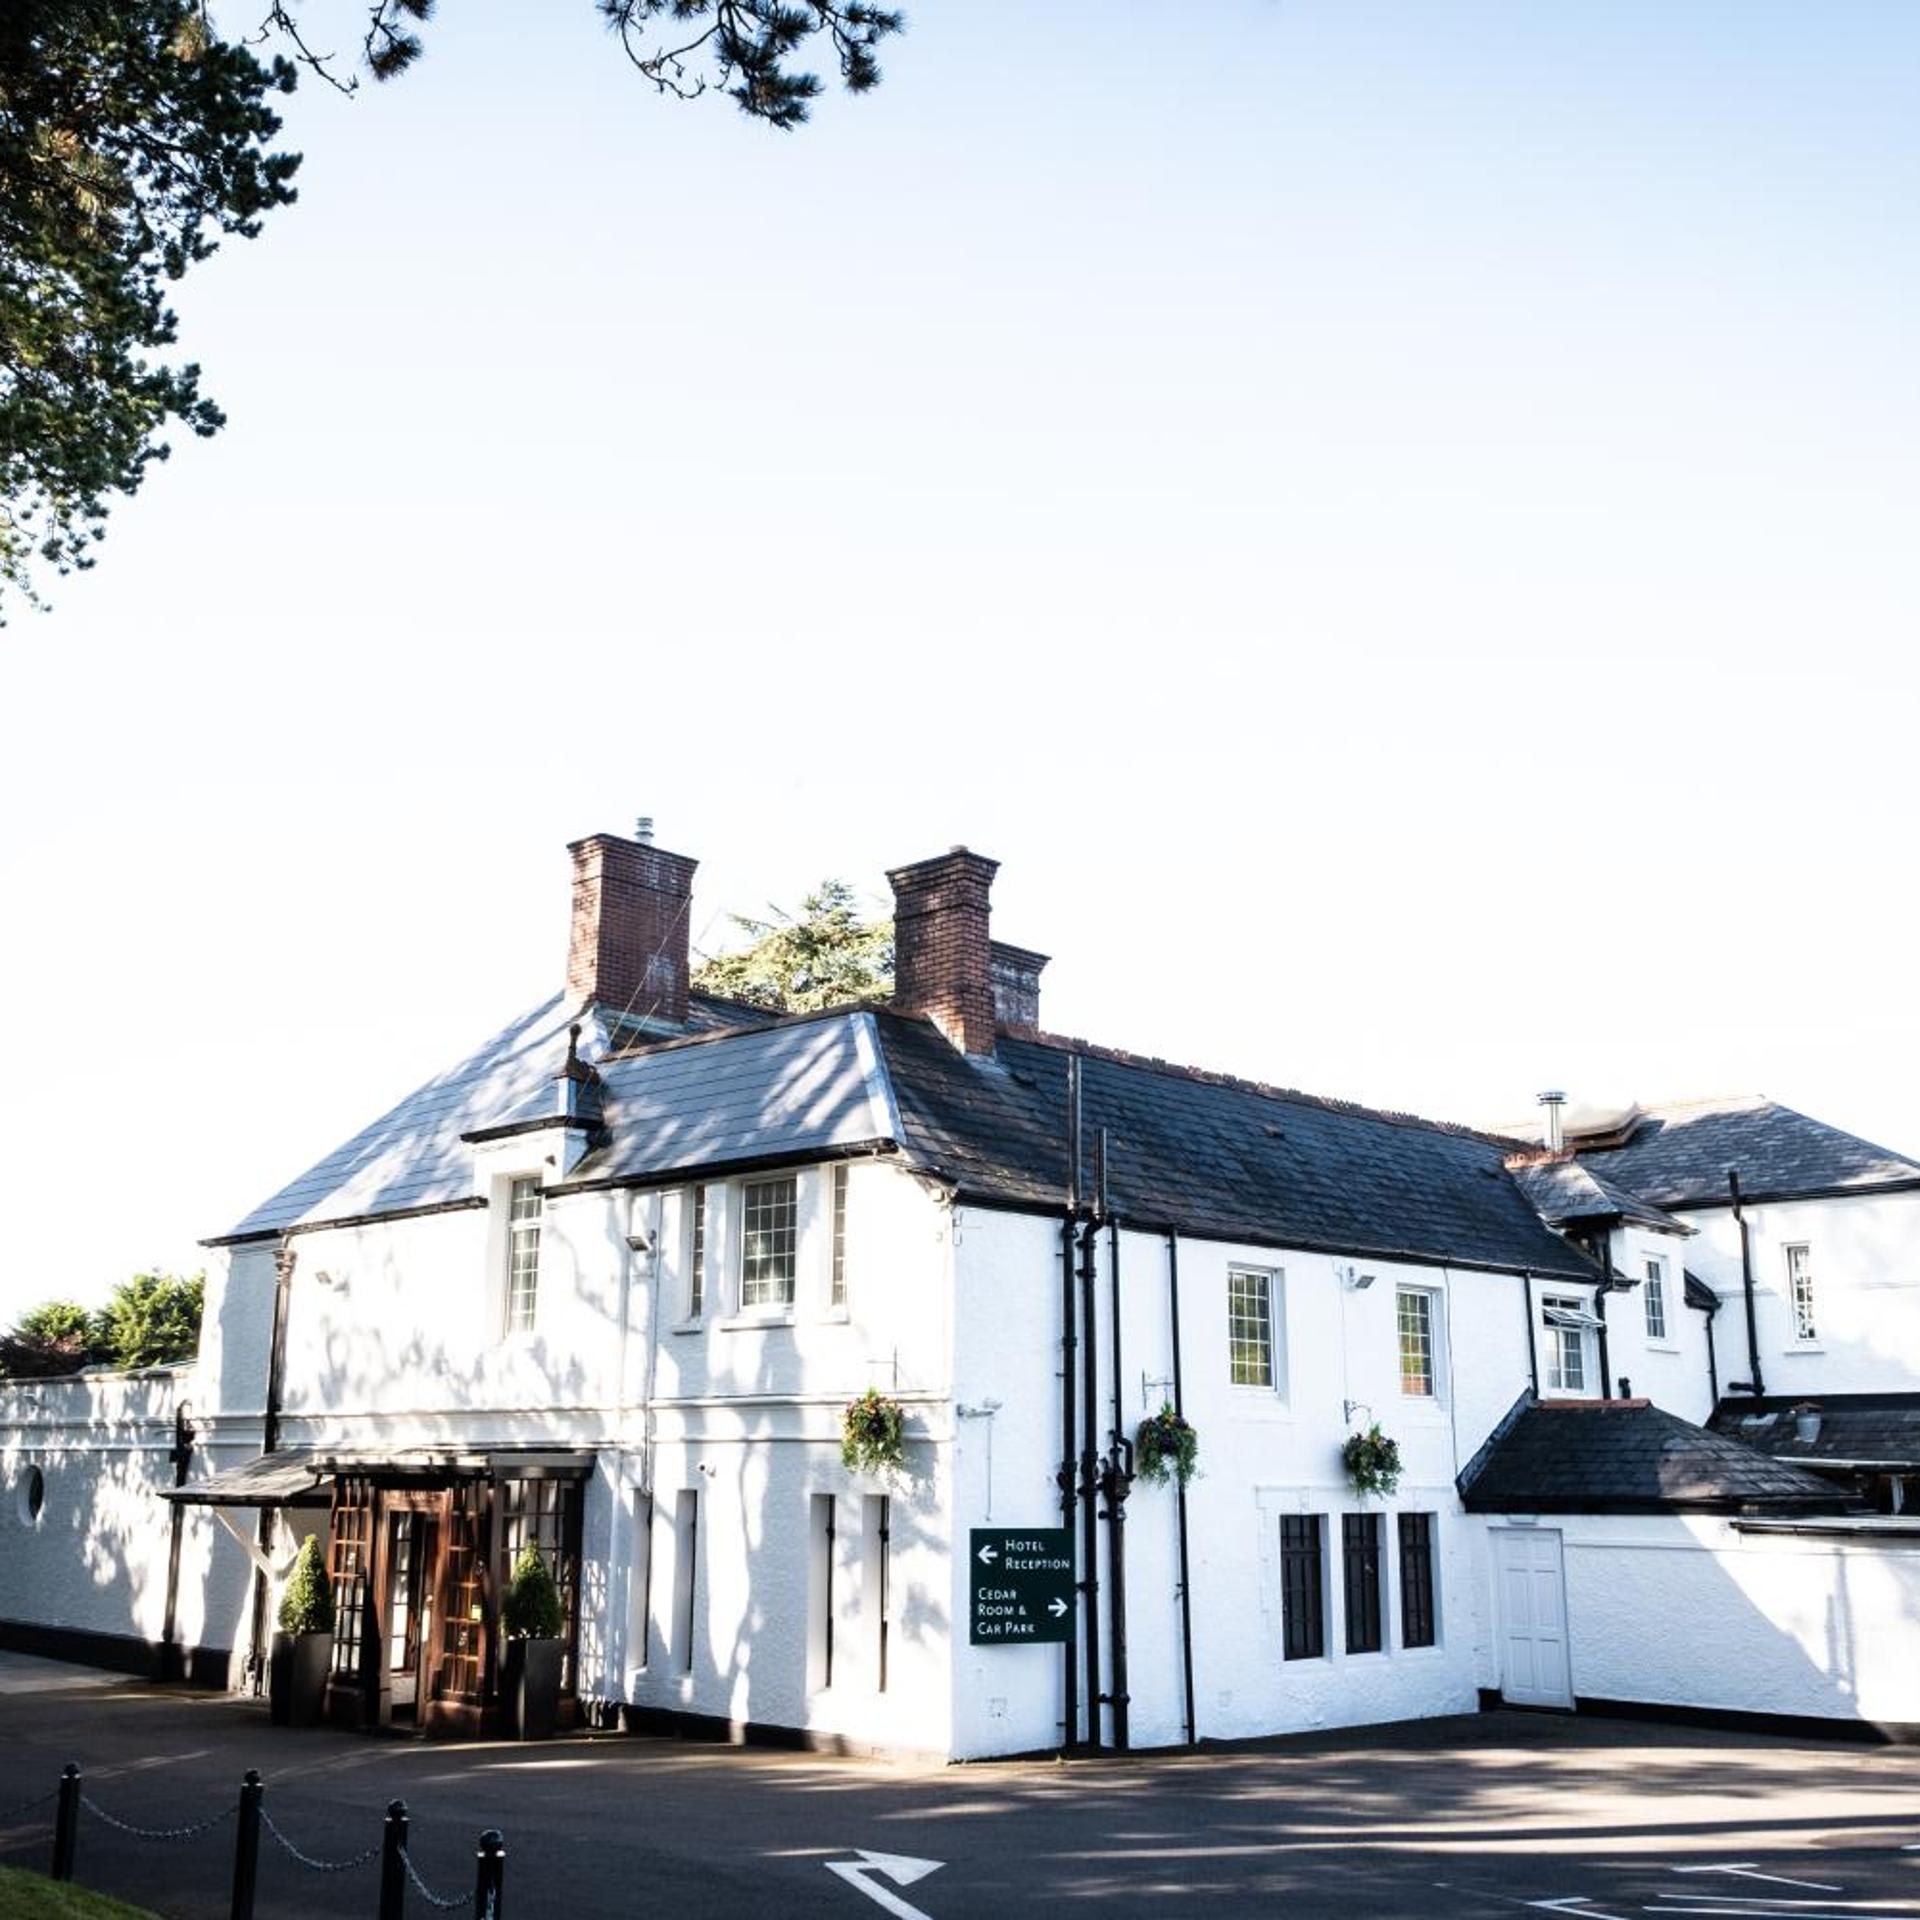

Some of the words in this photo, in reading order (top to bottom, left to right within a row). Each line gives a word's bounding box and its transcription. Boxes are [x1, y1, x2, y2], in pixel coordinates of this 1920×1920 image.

[1005, 1539, 1044, 1552] HOTEL
[1005, 1557, 1070, 1569] RECEPTION
[978, 1587, 1017, 1600] CEDAR
[978, 1603, 1014, 1616] ROOM
[977, 1622, 1001, 1635] CAR
